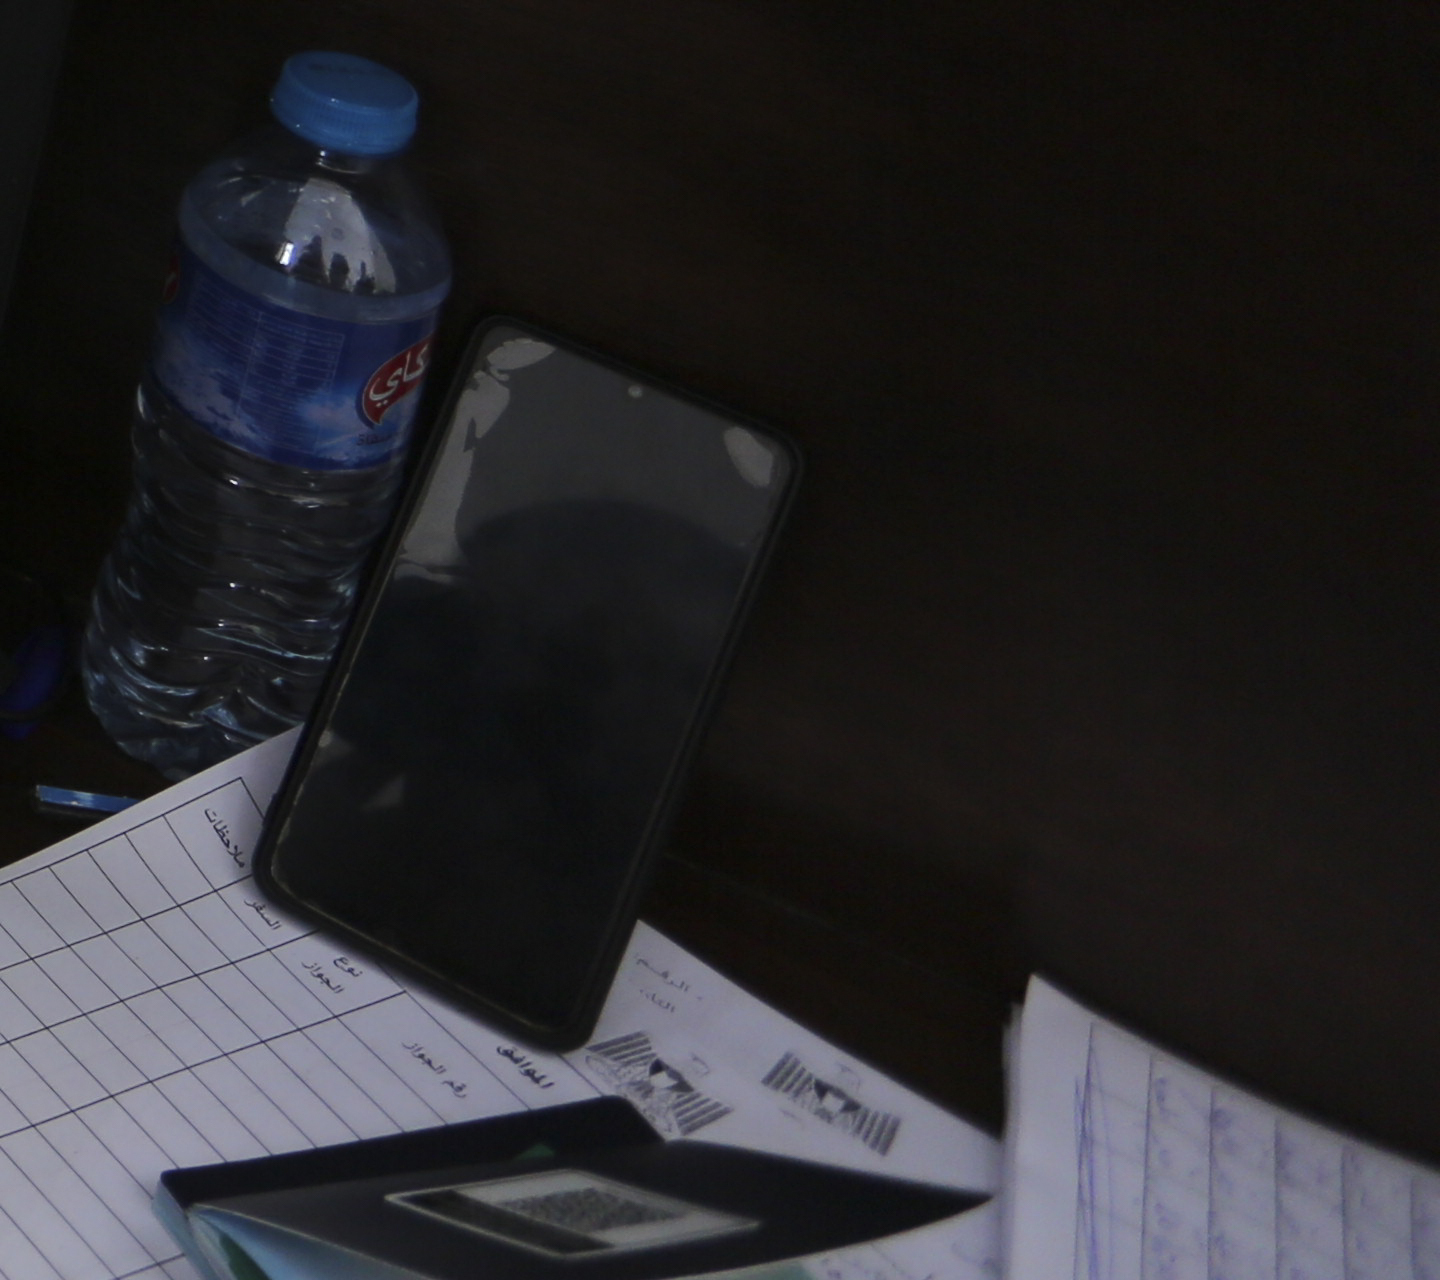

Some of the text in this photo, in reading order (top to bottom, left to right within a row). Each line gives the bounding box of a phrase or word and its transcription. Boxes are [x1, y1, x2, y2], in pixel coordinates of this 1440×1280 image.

[203, 806, 246, 870] ملاحظات
[243, 896, 282, 931] السفر
[301, 960, 345, 994] الجواز
[332, 955, 364, 978] نوع
[401, 1040, 468, 1099] رقم الجواز
[496, 1045, 556, 1090] الموافق
